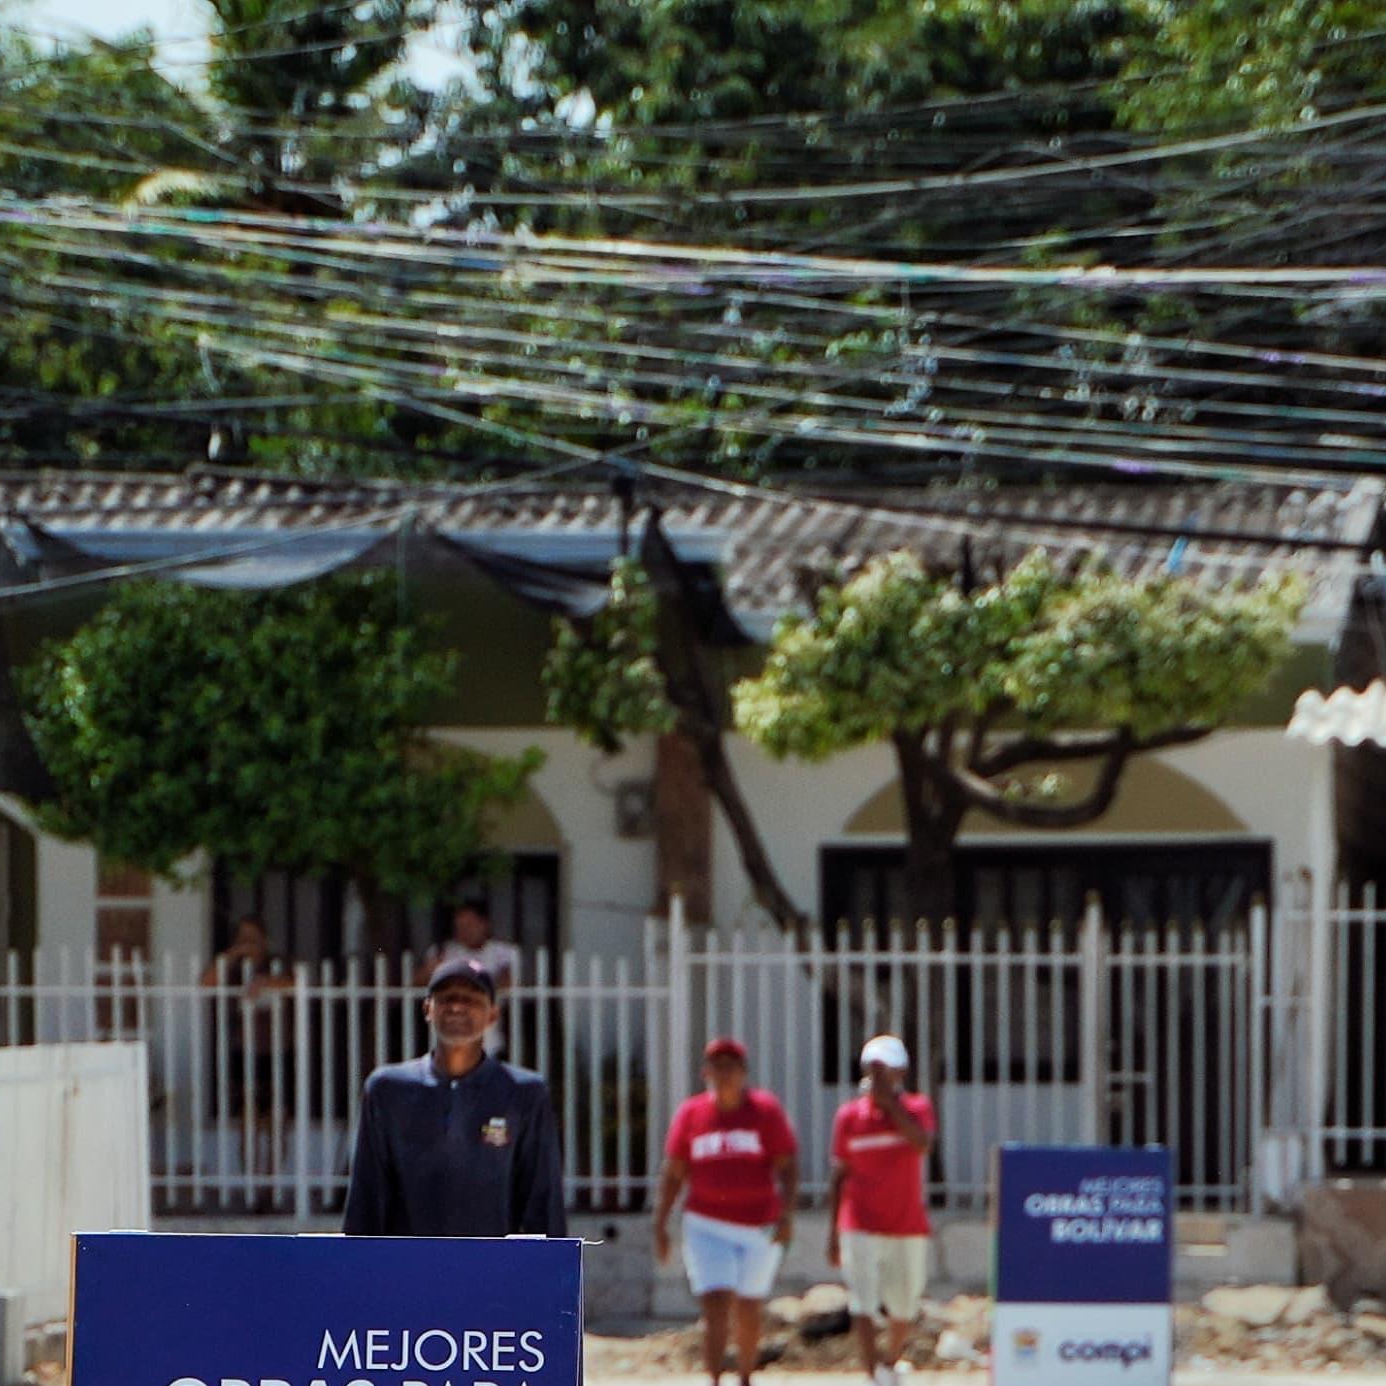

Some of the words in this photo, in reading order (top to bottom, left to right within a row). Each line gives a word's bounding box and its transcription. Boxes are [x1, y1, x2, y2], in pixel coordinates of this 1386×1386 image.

[1023, 1193, 1106, 1217] OBRAS
[317, 1329, 545, 1373] MEJORES
[1060, 1333, 1153, 1370] compi
